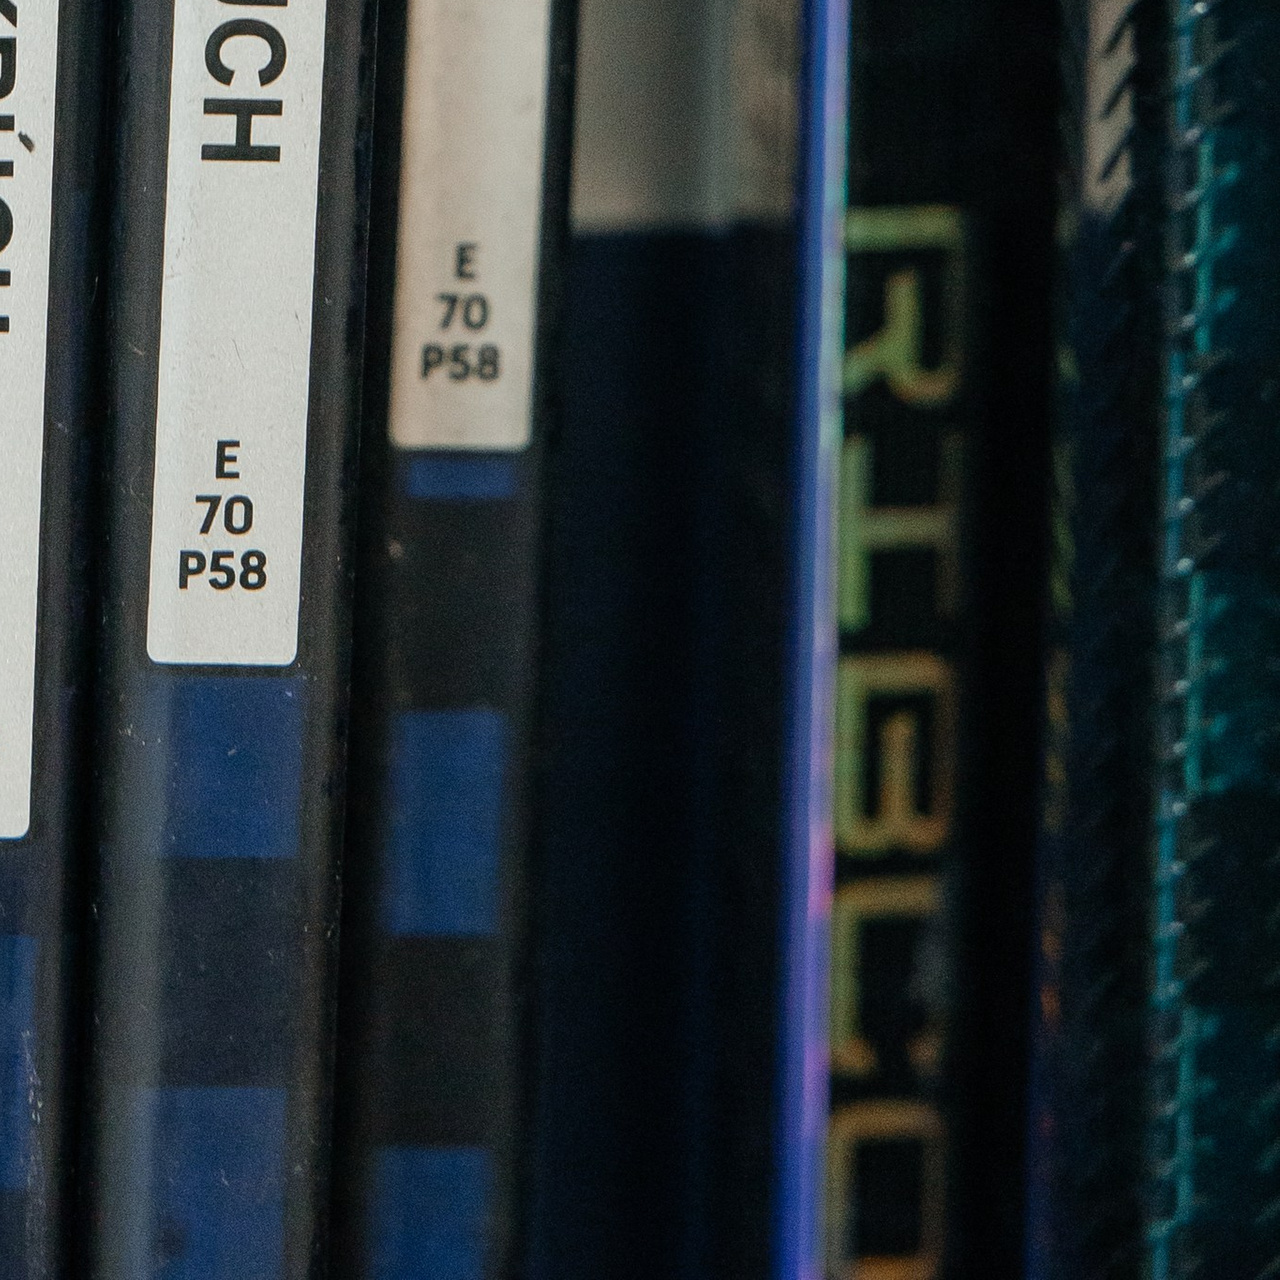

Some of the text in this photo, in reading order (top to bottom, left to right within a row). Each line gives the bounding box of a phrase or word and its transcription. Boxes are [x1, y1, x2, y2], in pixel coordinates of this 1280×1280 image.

[455, 244, 477, 281] E
[435, 294, 489, 331] 70
[419, 345, 500, 381] P58
[214, 439, 240, 479] E
[193, 495, 255, 535] 70
[176, 549, 268, 590] P58
